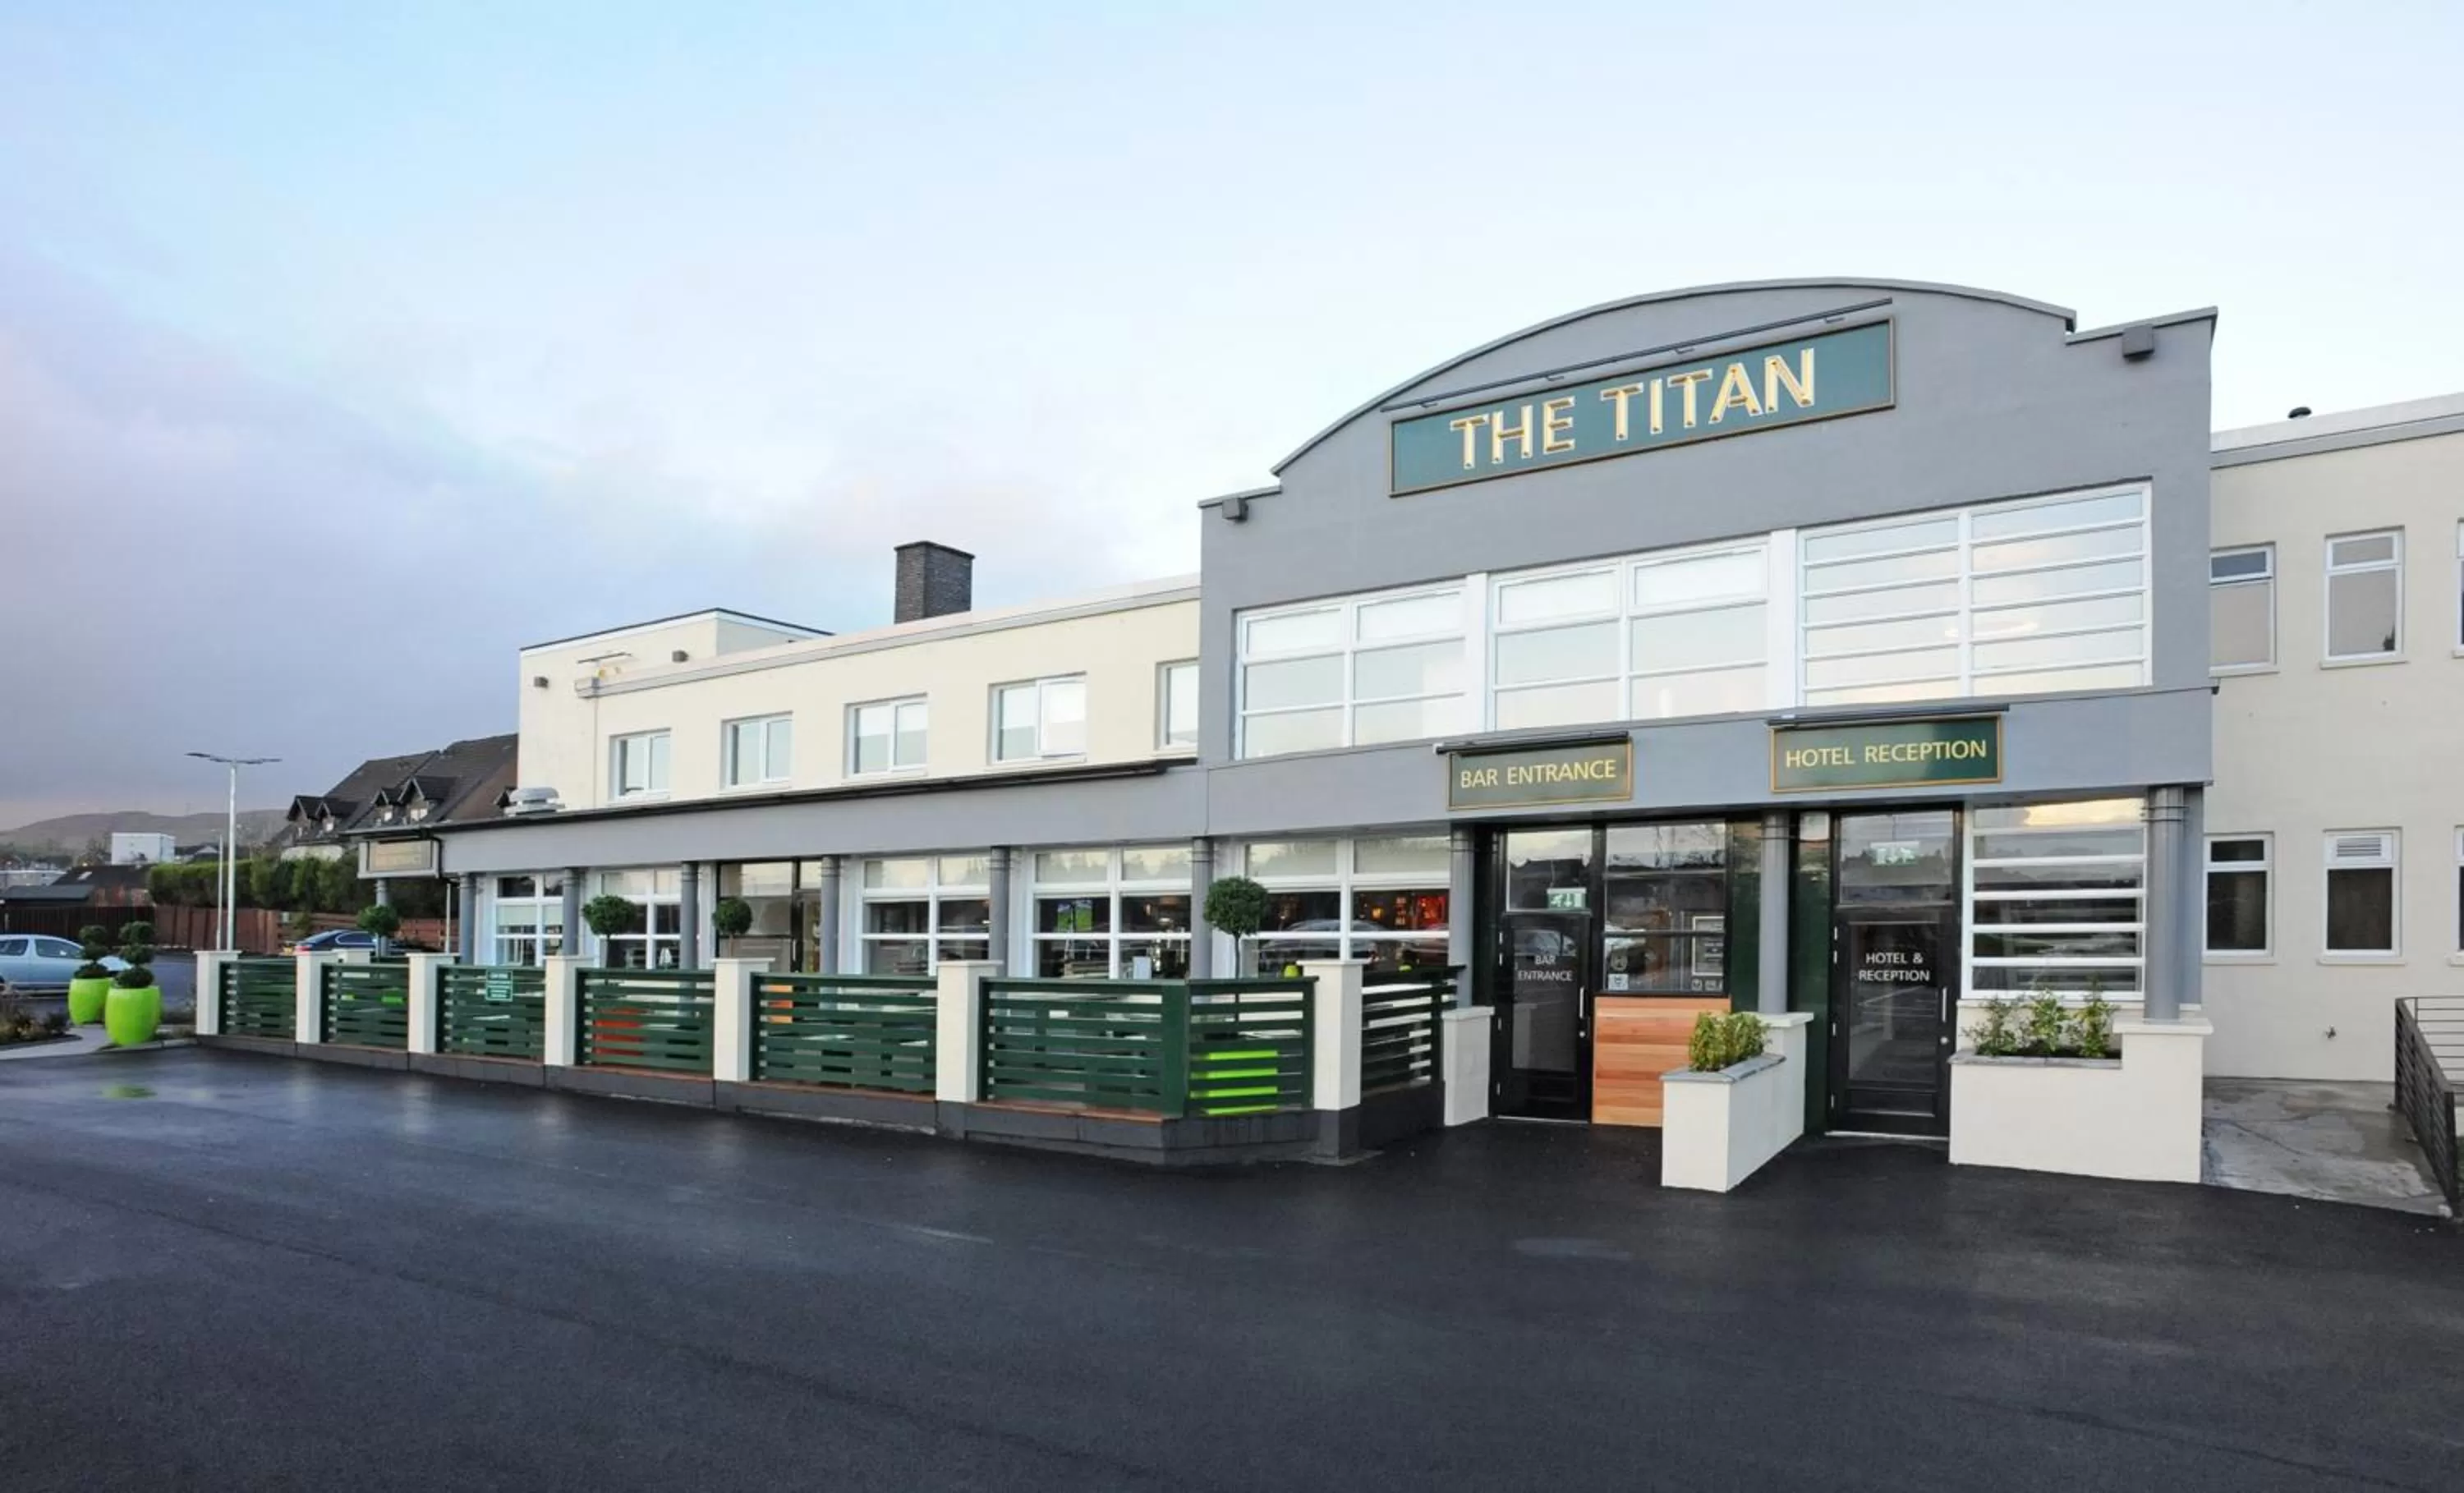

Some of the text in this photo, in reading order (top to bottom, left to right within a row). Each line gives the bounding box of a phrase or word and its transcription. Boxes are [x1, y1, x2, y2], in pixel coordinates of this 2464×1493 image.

[1450, 347, 1815, 470] THE TITAN
[1786, 739, 1987, 768] HOTEL RECEPTION
[1460, 759, 1617, 788] BAR ENTRANCE
[1534, 955, 1556, 965] BAR
[1865, 952, 1924, 964] HOTEL &
[1517, 970, 1573, 981] ENTRANCE
[1859, 969, 1930, 981] RECEPTION
